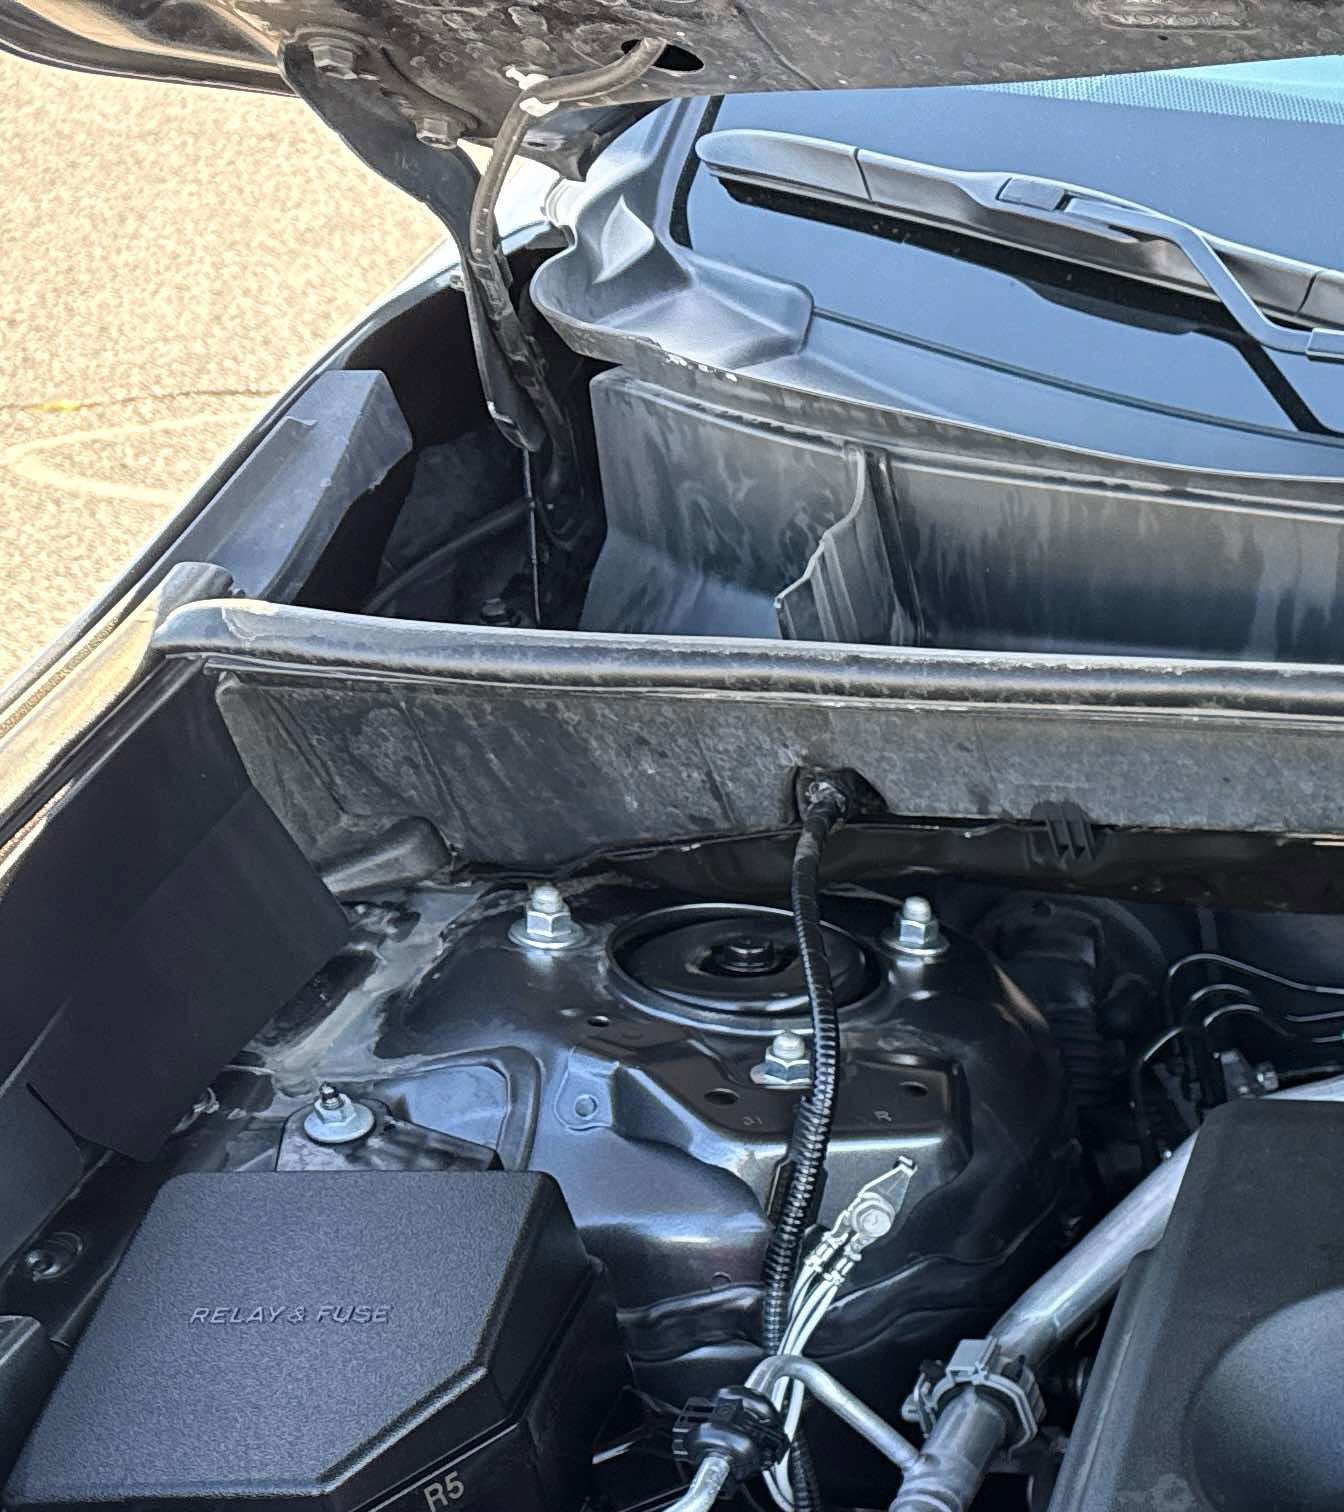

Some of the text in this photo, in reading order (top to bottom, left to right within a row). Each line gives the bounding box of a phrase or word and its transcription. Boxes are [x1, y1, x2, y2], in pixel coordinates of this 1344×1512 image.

[189, 1304, 392, 1325] RELAY & FUSE
